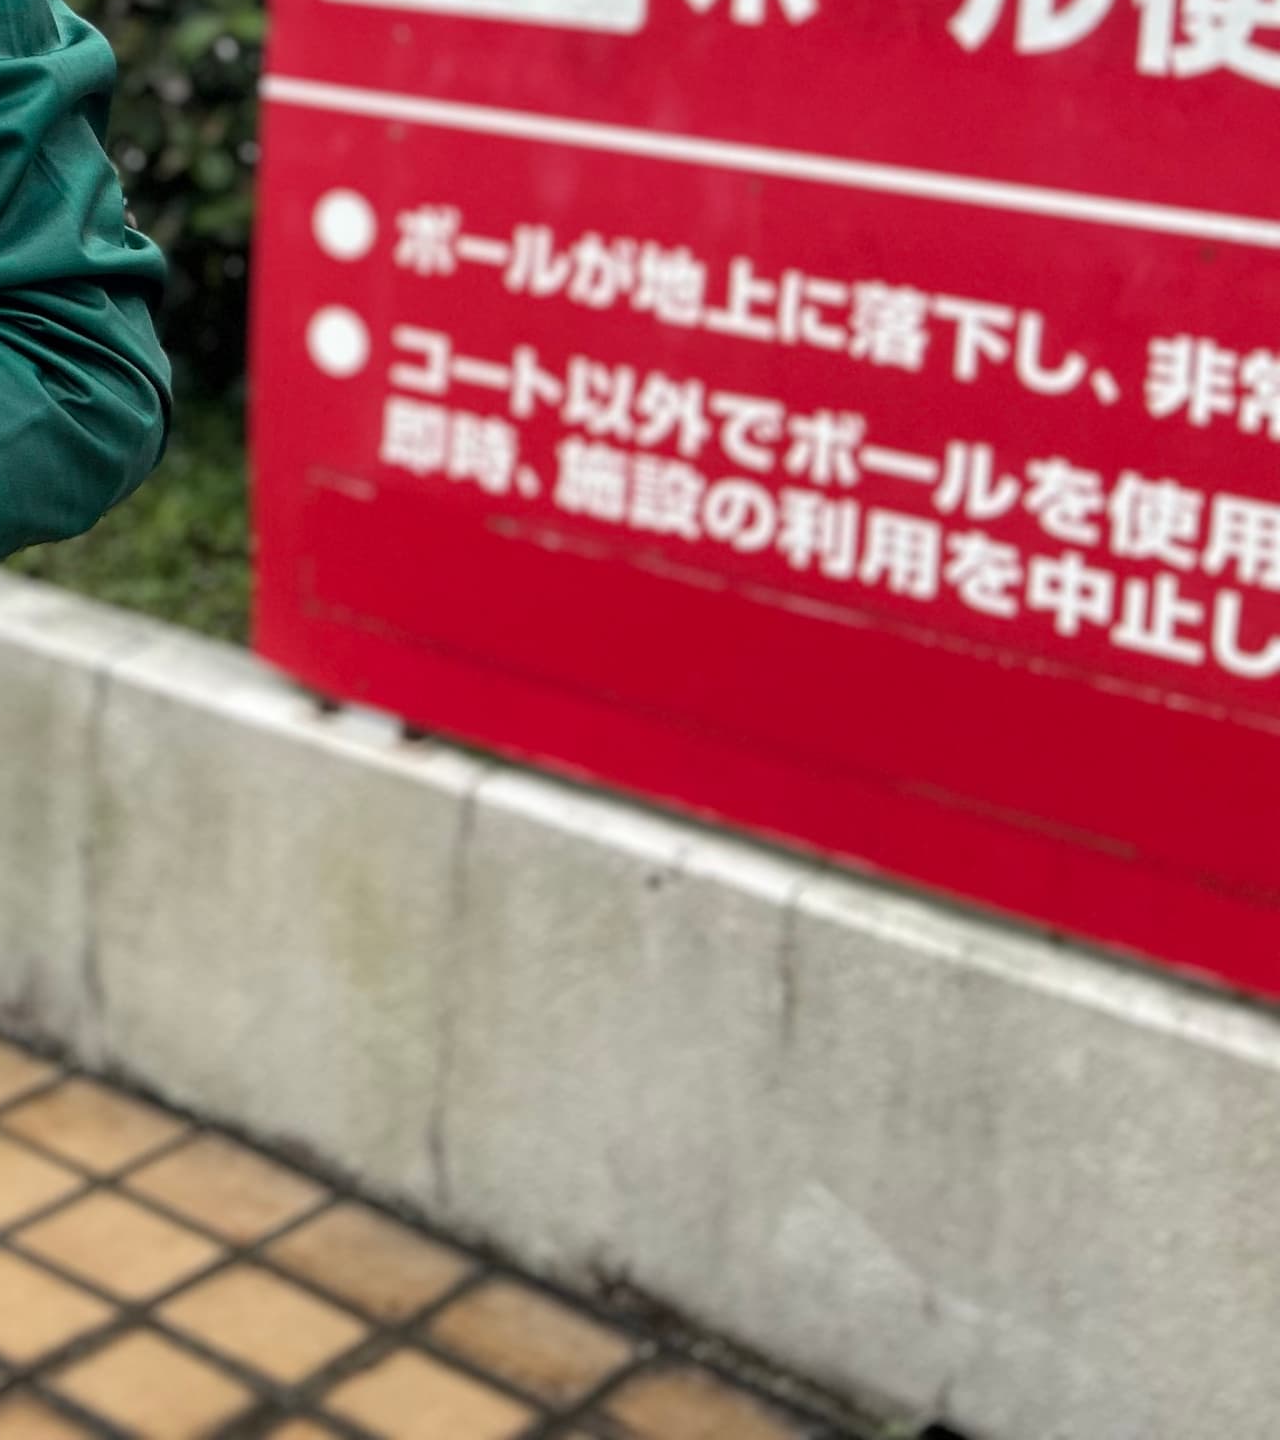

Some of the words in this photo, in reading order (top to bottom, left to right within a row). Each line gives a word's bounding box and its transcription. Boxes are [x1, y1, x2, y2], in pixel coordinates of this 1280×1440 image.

[389, 323, 1280, 593] コート以外でボールを使用
